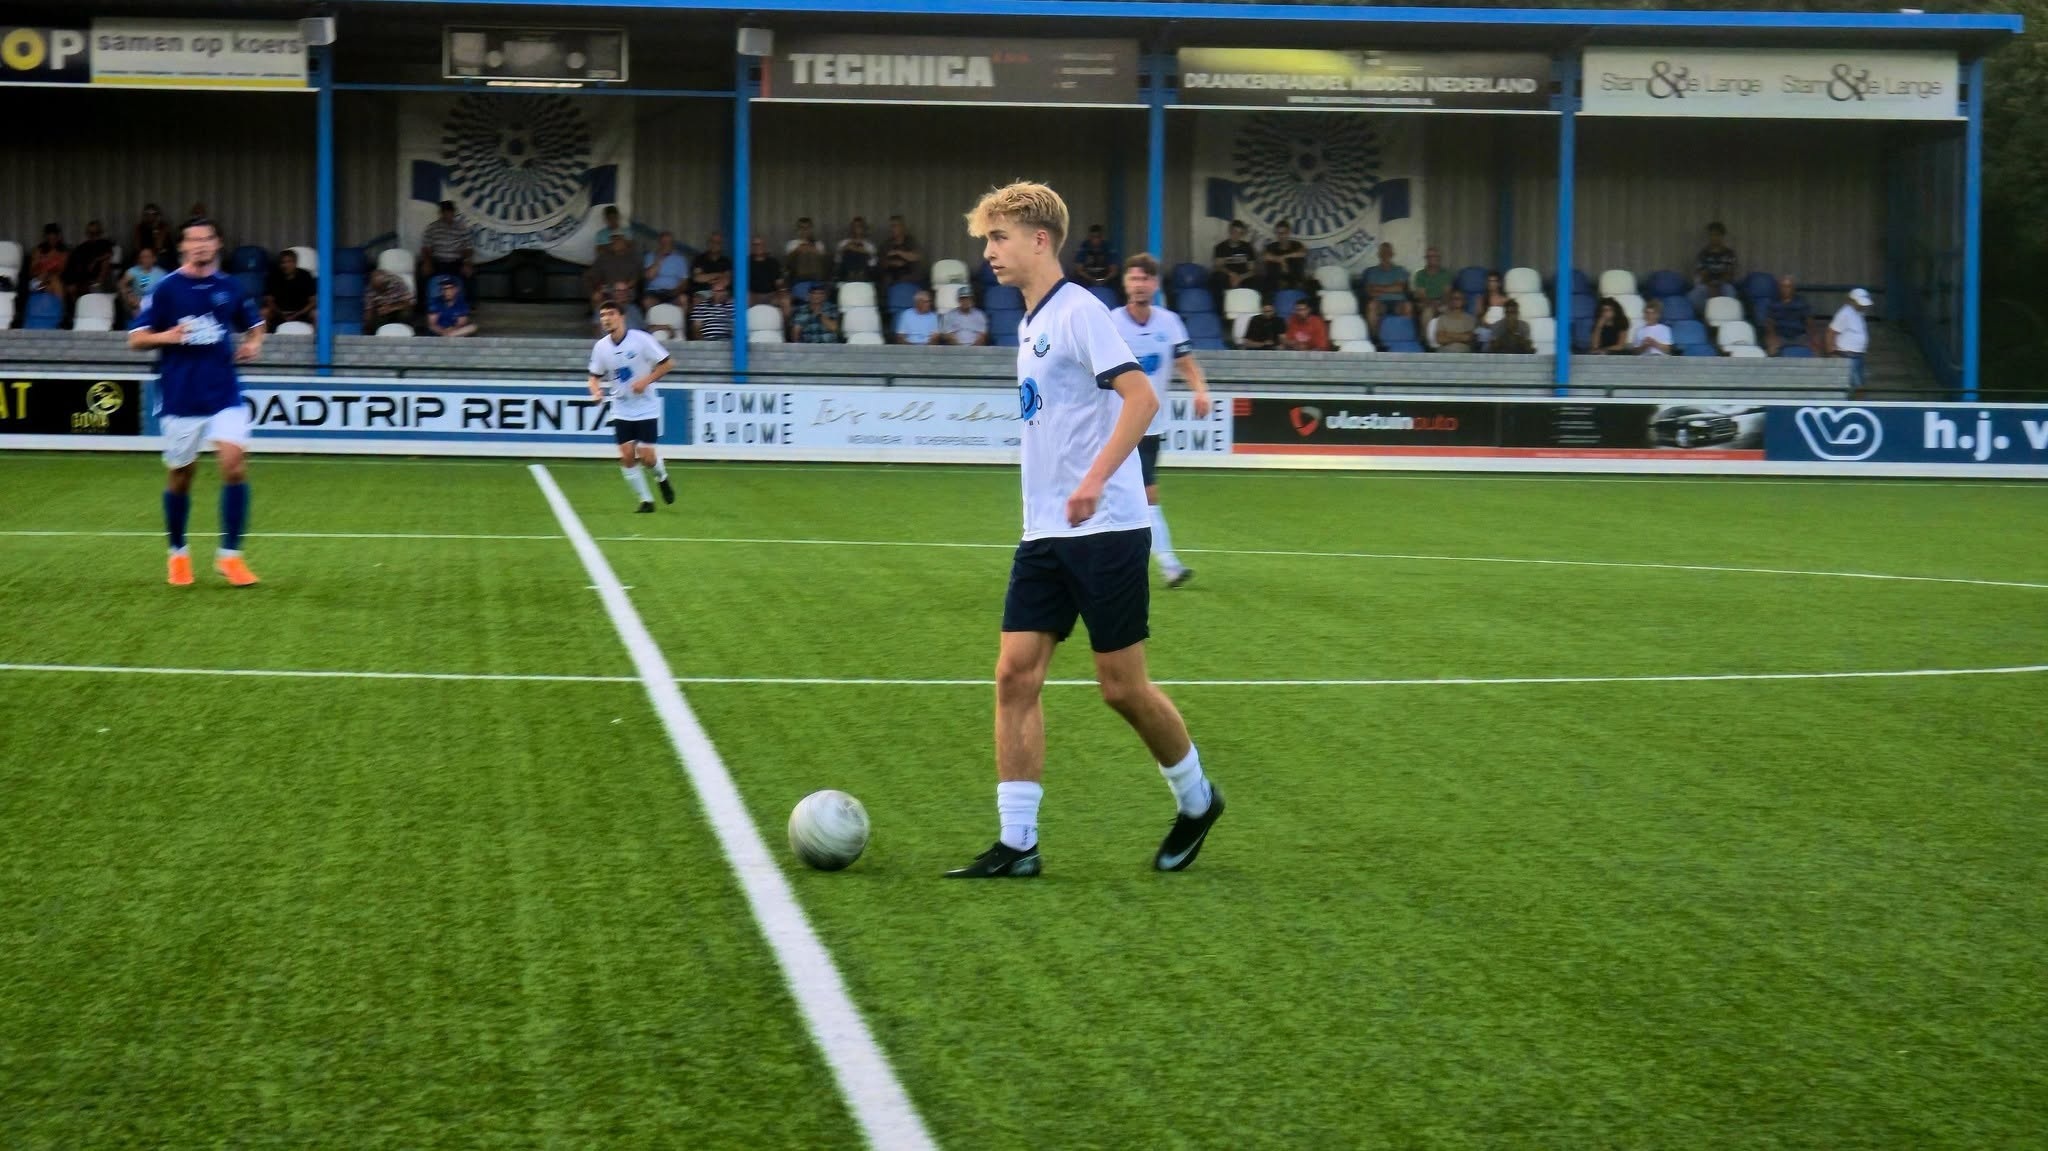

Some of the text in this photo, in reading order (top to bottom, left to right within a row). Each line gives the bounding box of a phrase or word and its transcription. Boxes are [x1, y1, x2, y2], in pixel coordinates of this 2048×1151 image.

[0, 28, 84, 71] OP
[98, 32, 300, 58] samen op koers
[789, 53, 995, 87] TECHNICA
[1184, 73, 1538, 94] DRANKENHANDEL MIDDEN NEDERLAND
[1705, 74, 1762, 97] Lange
[1886, 77, 1943, 99] Lange
[878, 400, 936, 422] all
[702, 422, 793, 445] & HOME
[1924, 411, 2010, 461] h.j.
